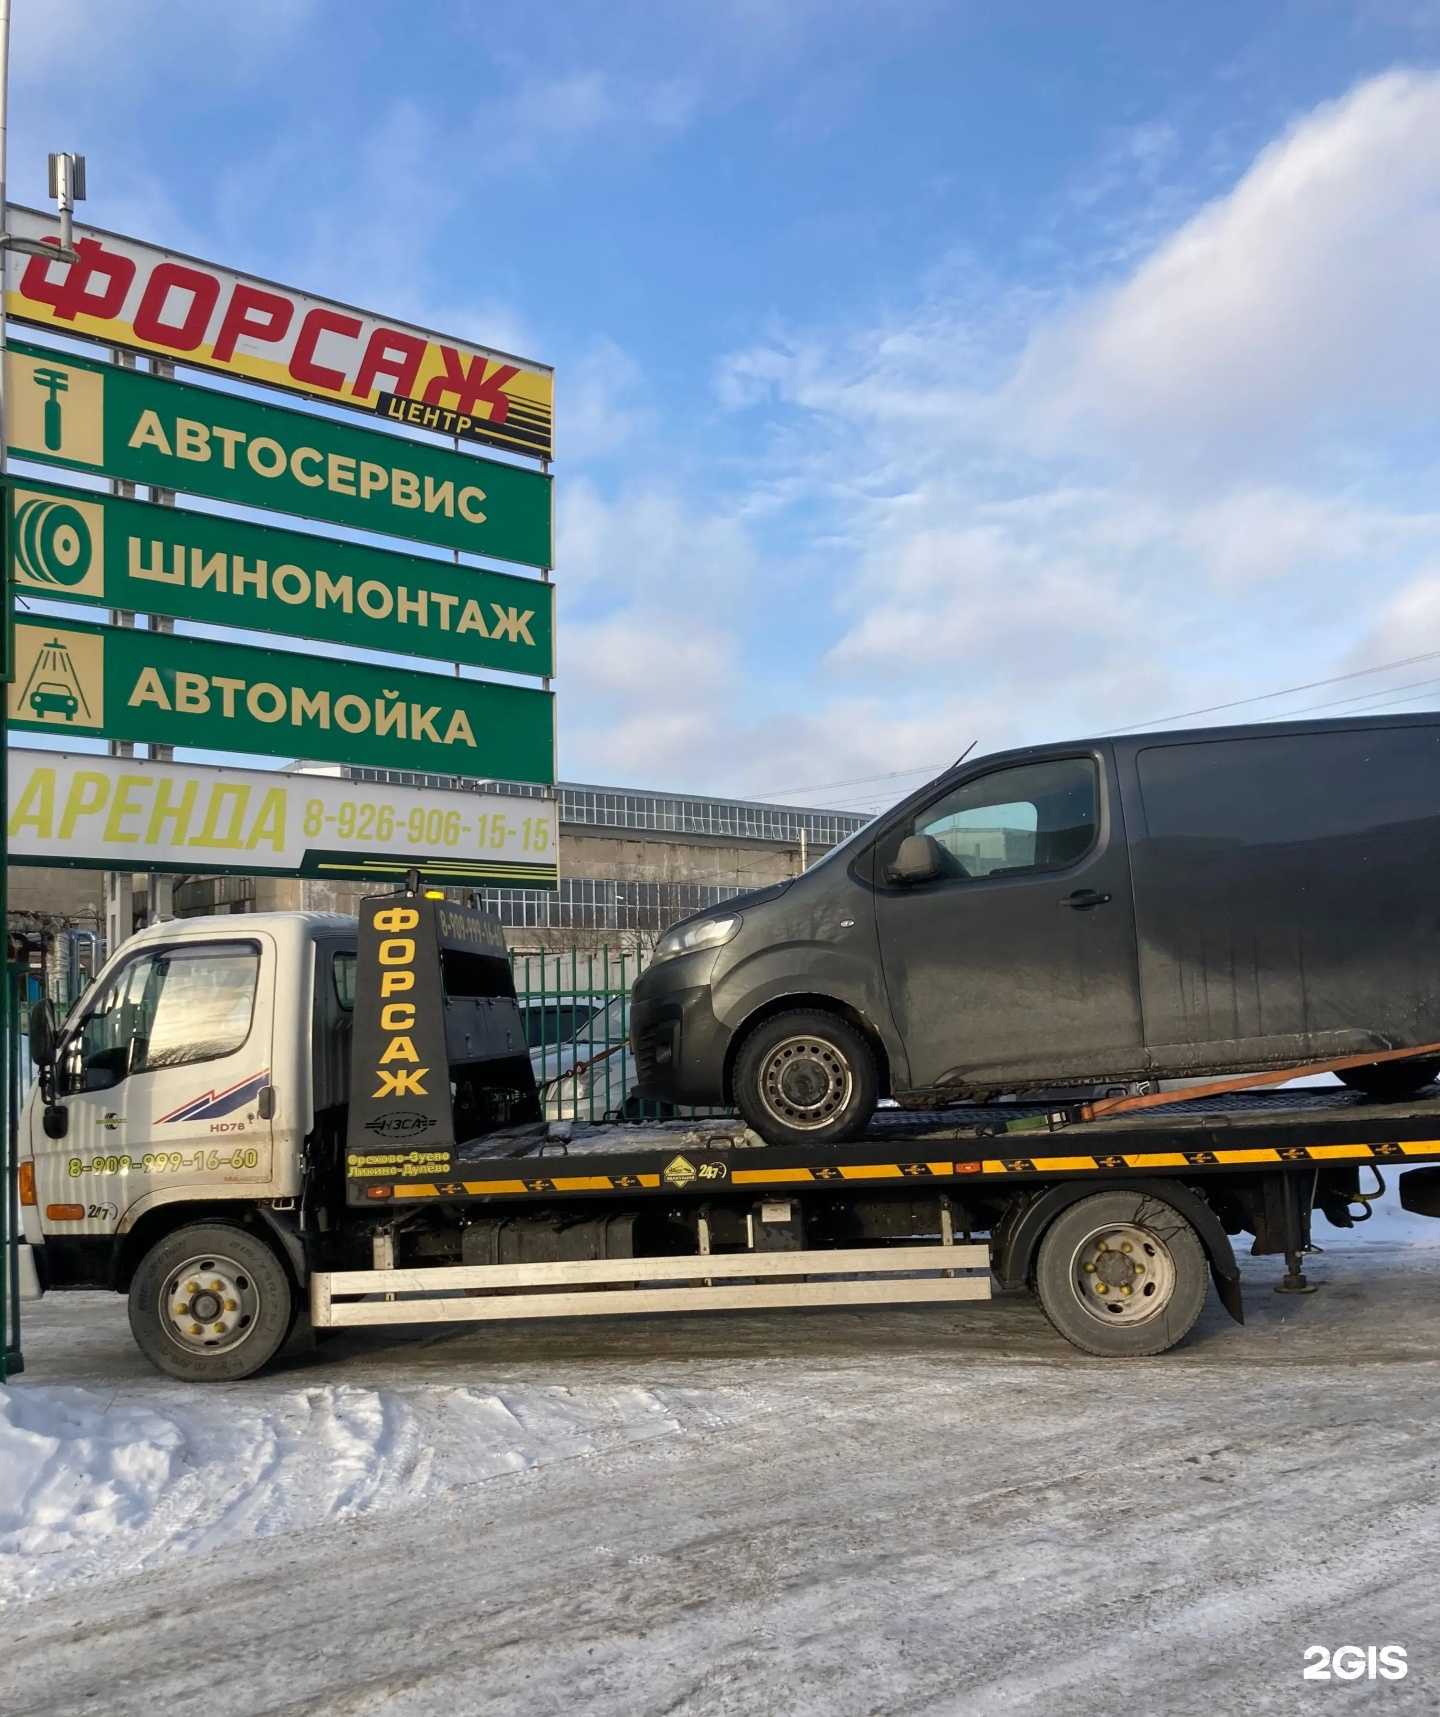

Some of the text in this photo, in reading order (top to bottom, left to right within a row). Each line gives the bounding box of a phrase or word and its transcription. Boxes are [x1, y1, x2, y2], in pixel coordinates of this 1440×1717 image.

[19, 236, 521, 425] ФОРСАЖ
[387, 397, 472, 434] ЦЕНТР
[127, 408, 488, 525] АВТОСЕРВИС
[127, 536, 536, 647] ШИНОМОНТАЖ
[127, 667, 477, 748] АВТОМОЙКА
[8, 767, 549, 852] АРЕНДА 8-926-906-15-15
[371, 907, 430, 1098] ФОРСАЖ
[68, 1148, 258, 1178] 8-909-999-16-60
[210, 1122, 245, 1132] HD78
